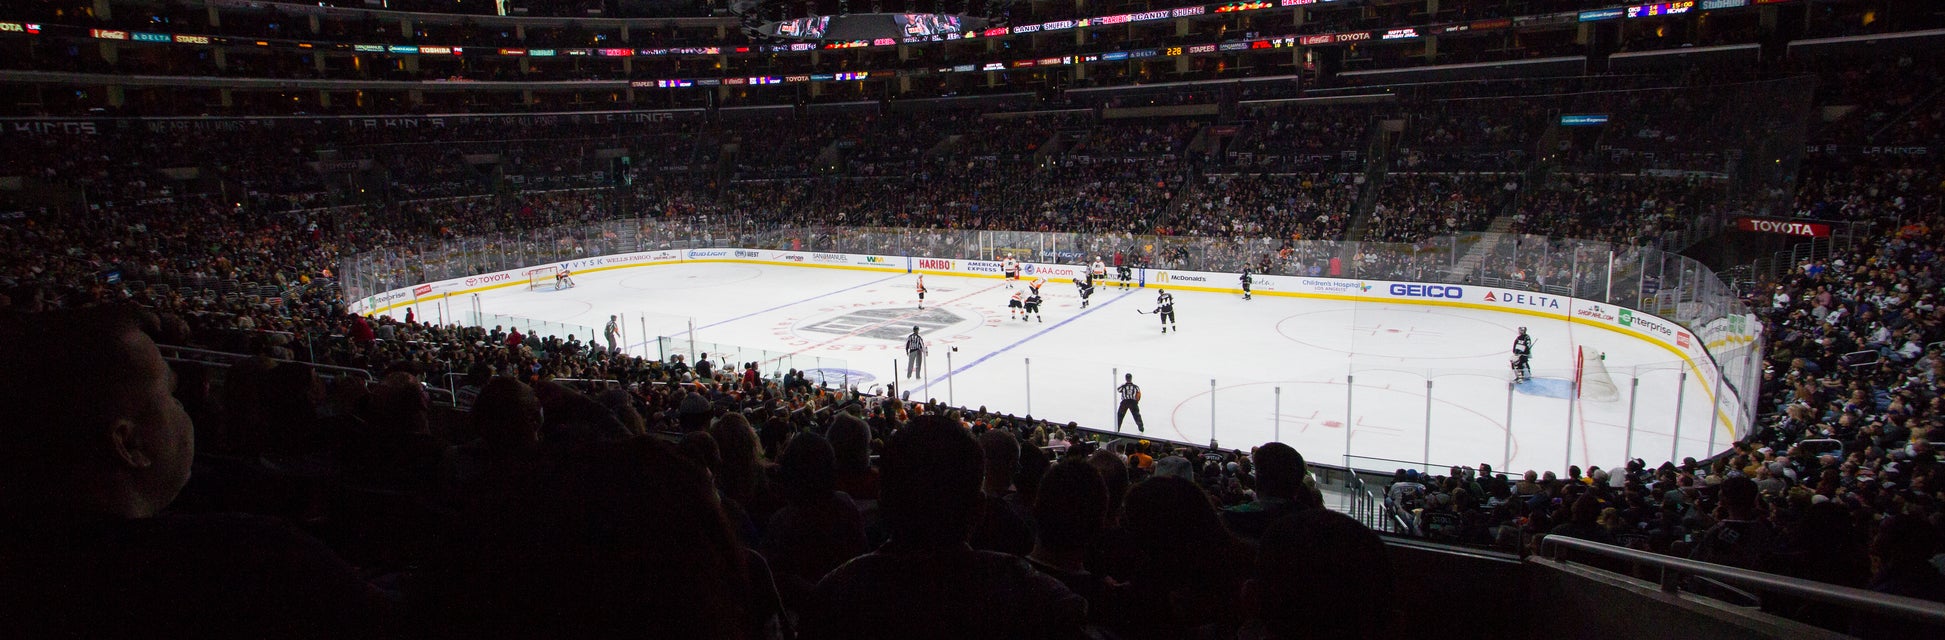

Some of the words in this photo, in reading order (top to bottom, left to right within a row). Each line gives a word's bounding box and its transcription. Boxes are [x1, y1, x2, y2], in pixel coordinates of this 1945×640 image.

[1135, 12, 1169, 21] CANDY
[1013, 25, 1040, 34] CANDY
[175, 35, 208, 44] STAPLES
[1335, 32, 1370, 42] TOYOTA
[1190, 45, 1215, 54] STAPLES
[1884, 146, 1926, 155] KINGS
[1750, 219, 1814, 237] TOYOTA
[919, 260, 950, 270] HARIBO
[1035, 266, 1073, 276] AAA.com
[479, 273, 510, 283] TOYOTA
[1171, 274, 1206, 283] McDonald's
[1333, 281, 1360, 289] Hospital
[1390, 283, 1463, 299] GEICO
[1503, 292, 1559, 309] DELTA
[1620, 312, 1671, 335] enterprise
